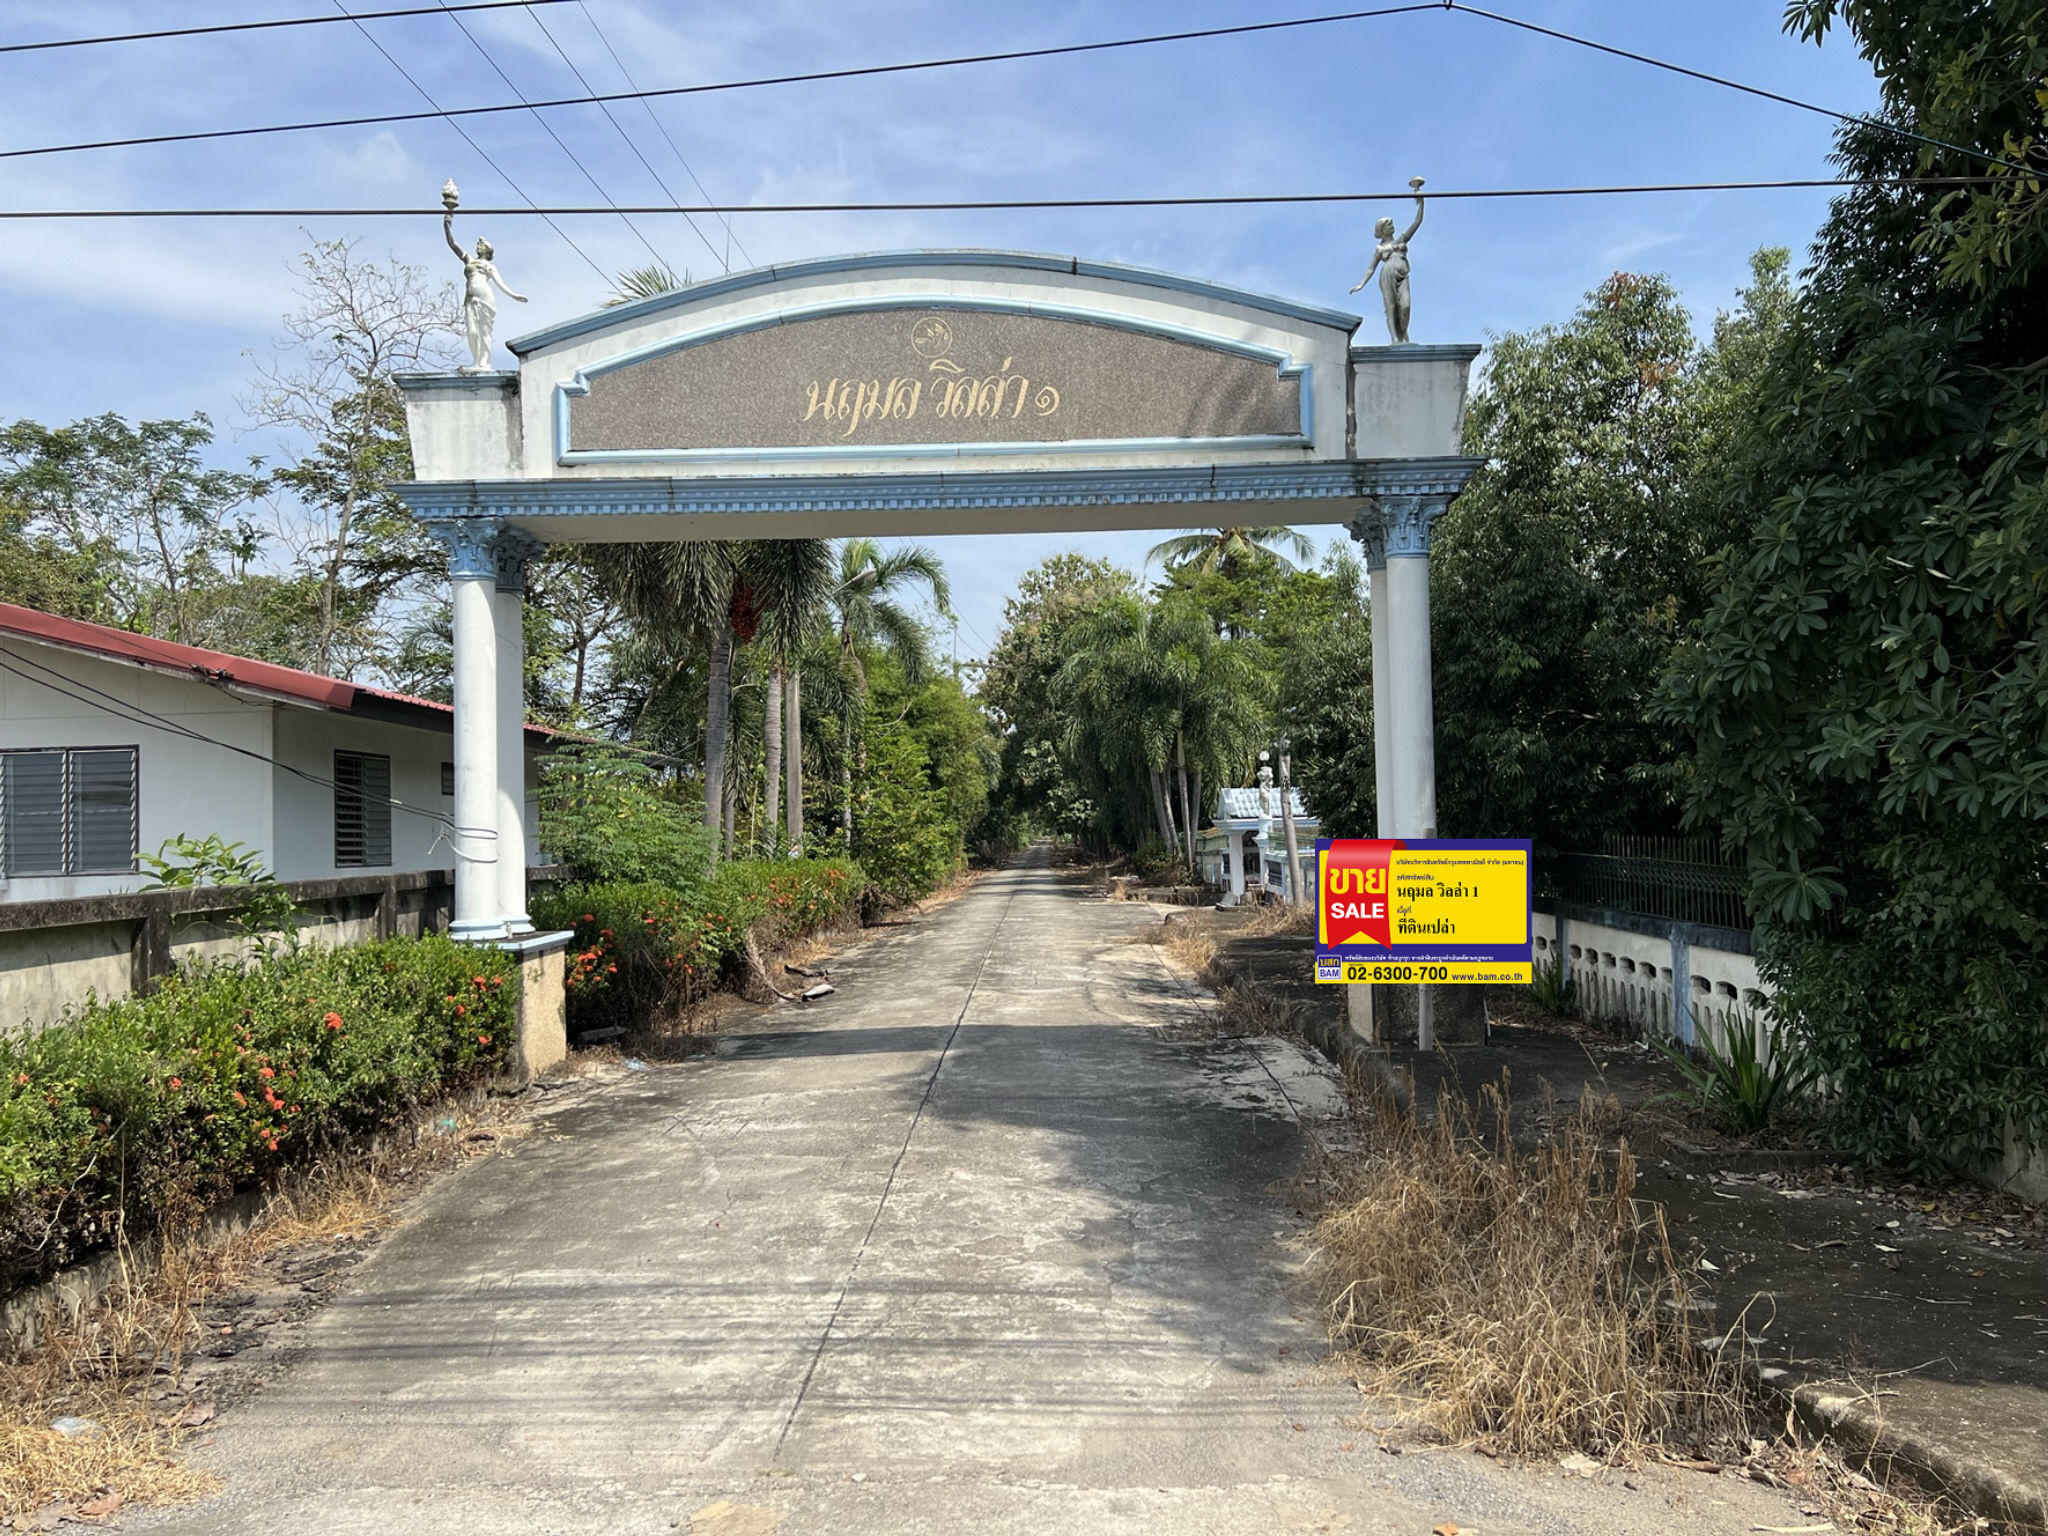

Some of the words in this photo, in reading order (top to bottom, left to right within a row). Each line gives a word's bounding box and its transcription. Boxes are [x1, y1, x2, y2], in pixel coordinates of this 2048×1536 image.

[803, 376, 922, 438] นฤมล
[929, 356, 1029, 419] วิลล่า
[1034, 383, 1061, 417] ๑
[1330, 868, 1386, 895] ขาย
[1396, 885, 1434, 902] นฤมล
[1437, 881, 1469, 898] วิลล่า
[1473, 885, 1478, 898] 1
[1331, 902, 1385, 919] SALE
[1397, 914, 1455, 935] ที่ดินเปล่า
[1319, 958, 1340, 967] บสก
[1319, 969, 1340, 978] BAM
[1347, 966, 1448, 981] 02-6300-700
[1452, 972, 1523, 981] www.bam.co.th
